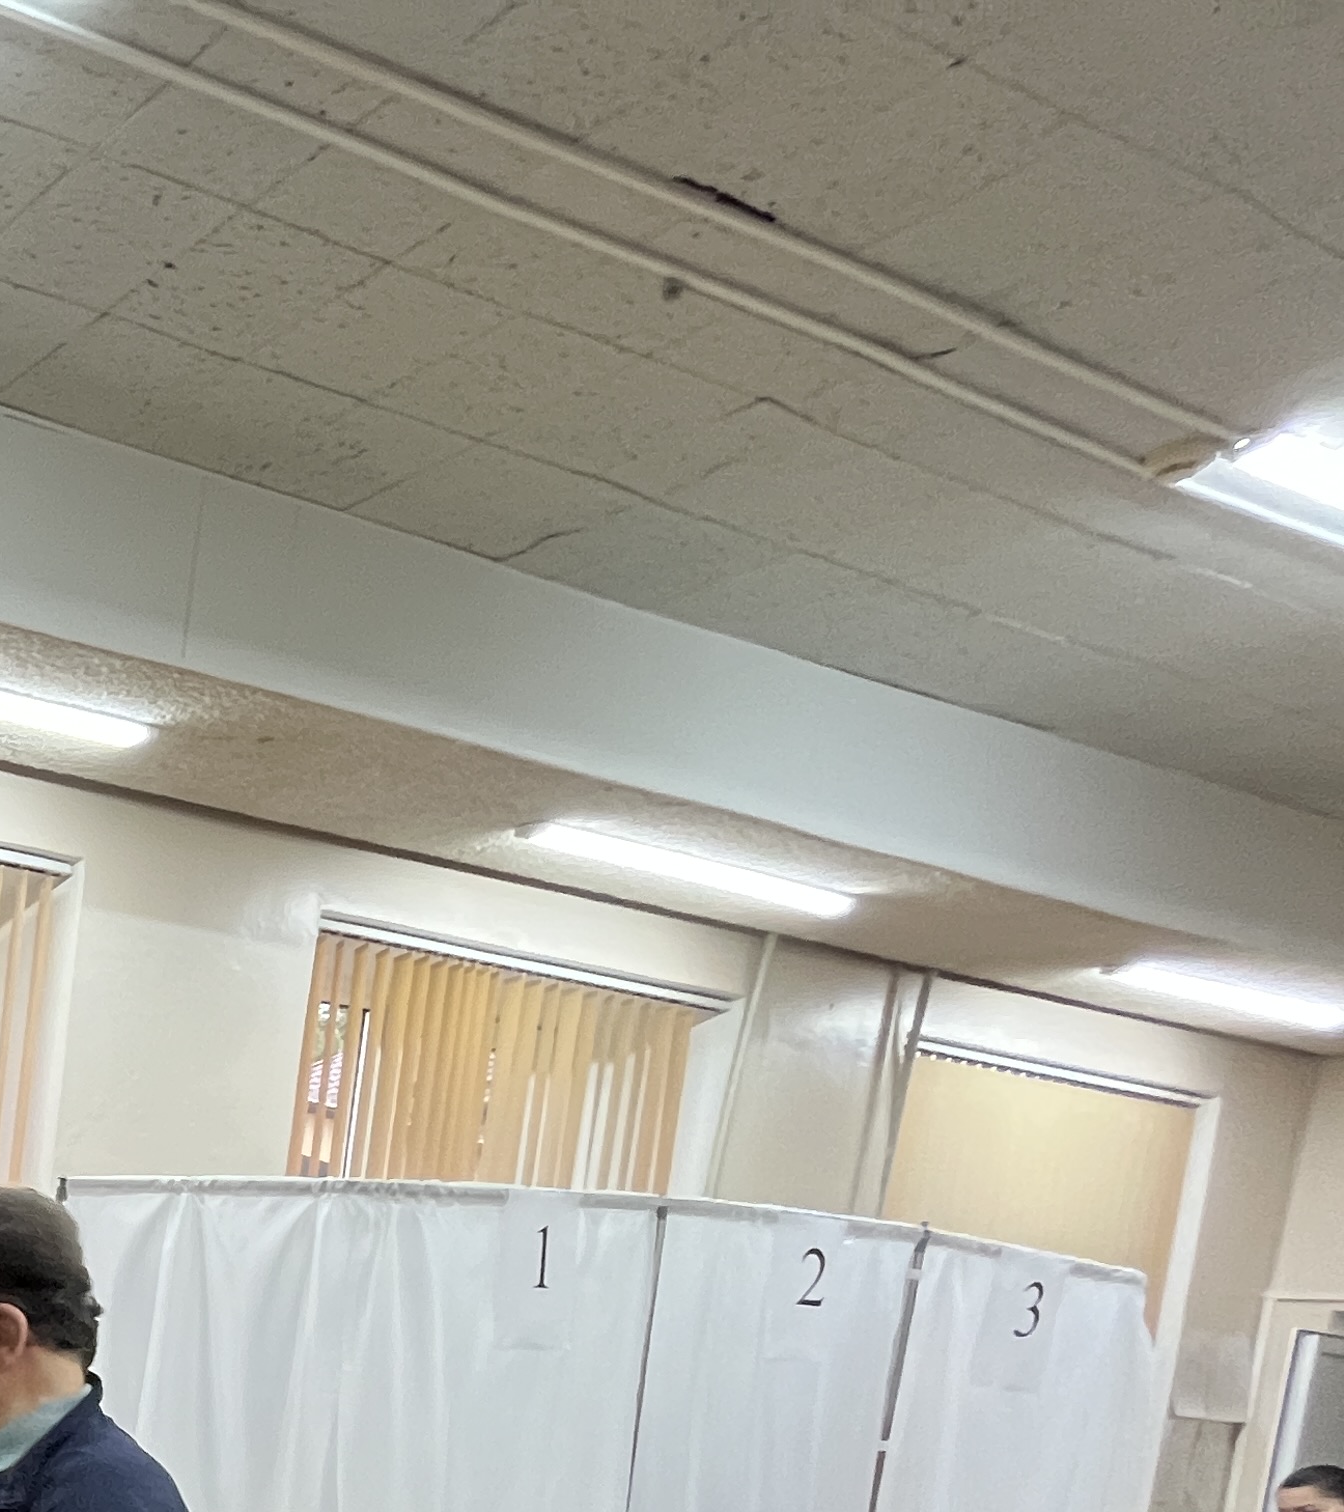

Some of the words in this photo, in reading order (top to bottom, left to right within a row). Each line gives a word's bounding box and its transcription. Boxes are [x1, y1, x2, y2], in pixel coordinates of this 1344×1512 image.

[532, 1224, 550, 1289] 1
[795, 1247, 826, 1307] 2
[1013, 1281, 1044, 1338] 3
